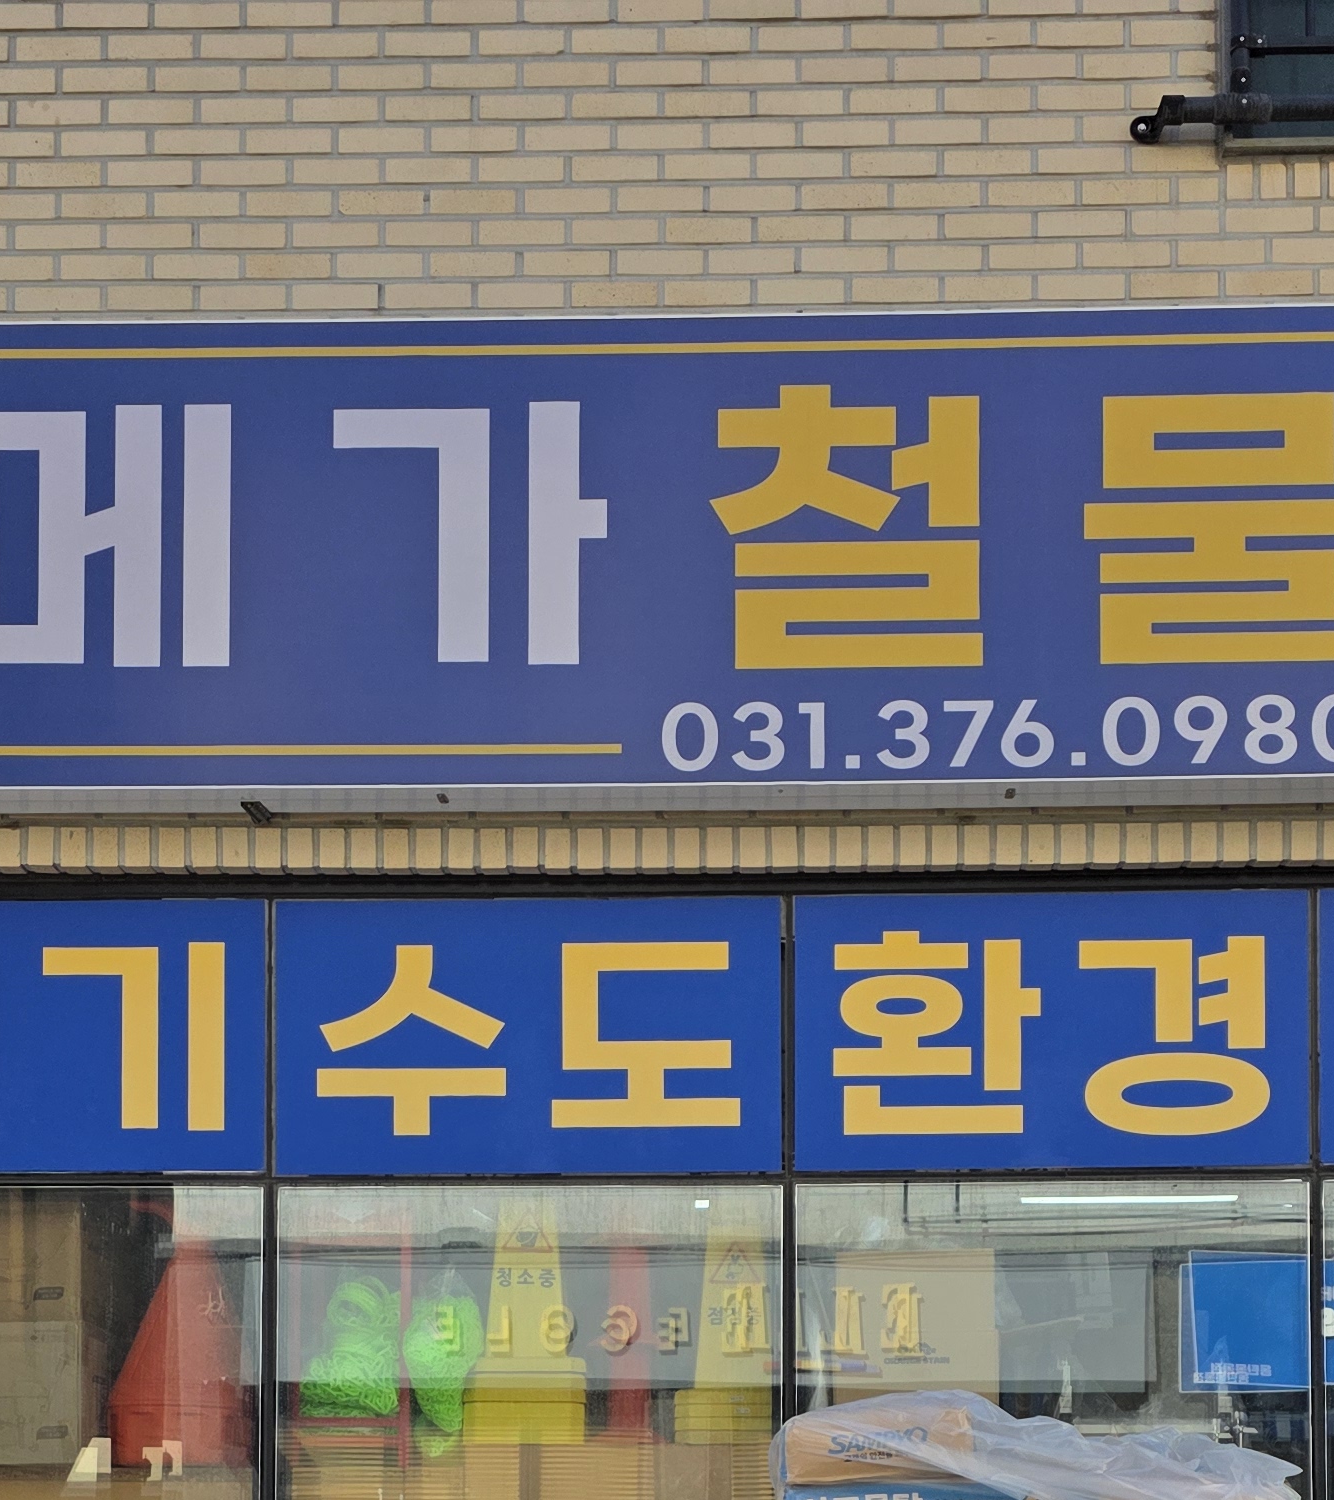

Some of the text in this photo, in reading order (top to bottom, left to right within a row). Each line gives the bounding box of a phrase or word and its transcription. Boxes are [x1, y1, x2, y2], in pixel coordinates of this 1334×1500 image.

[317, 941, 741, 1136] 수도
[833, 930, 1271, 1136] 환경
[495, 1266, 557, 1288] 청소중
